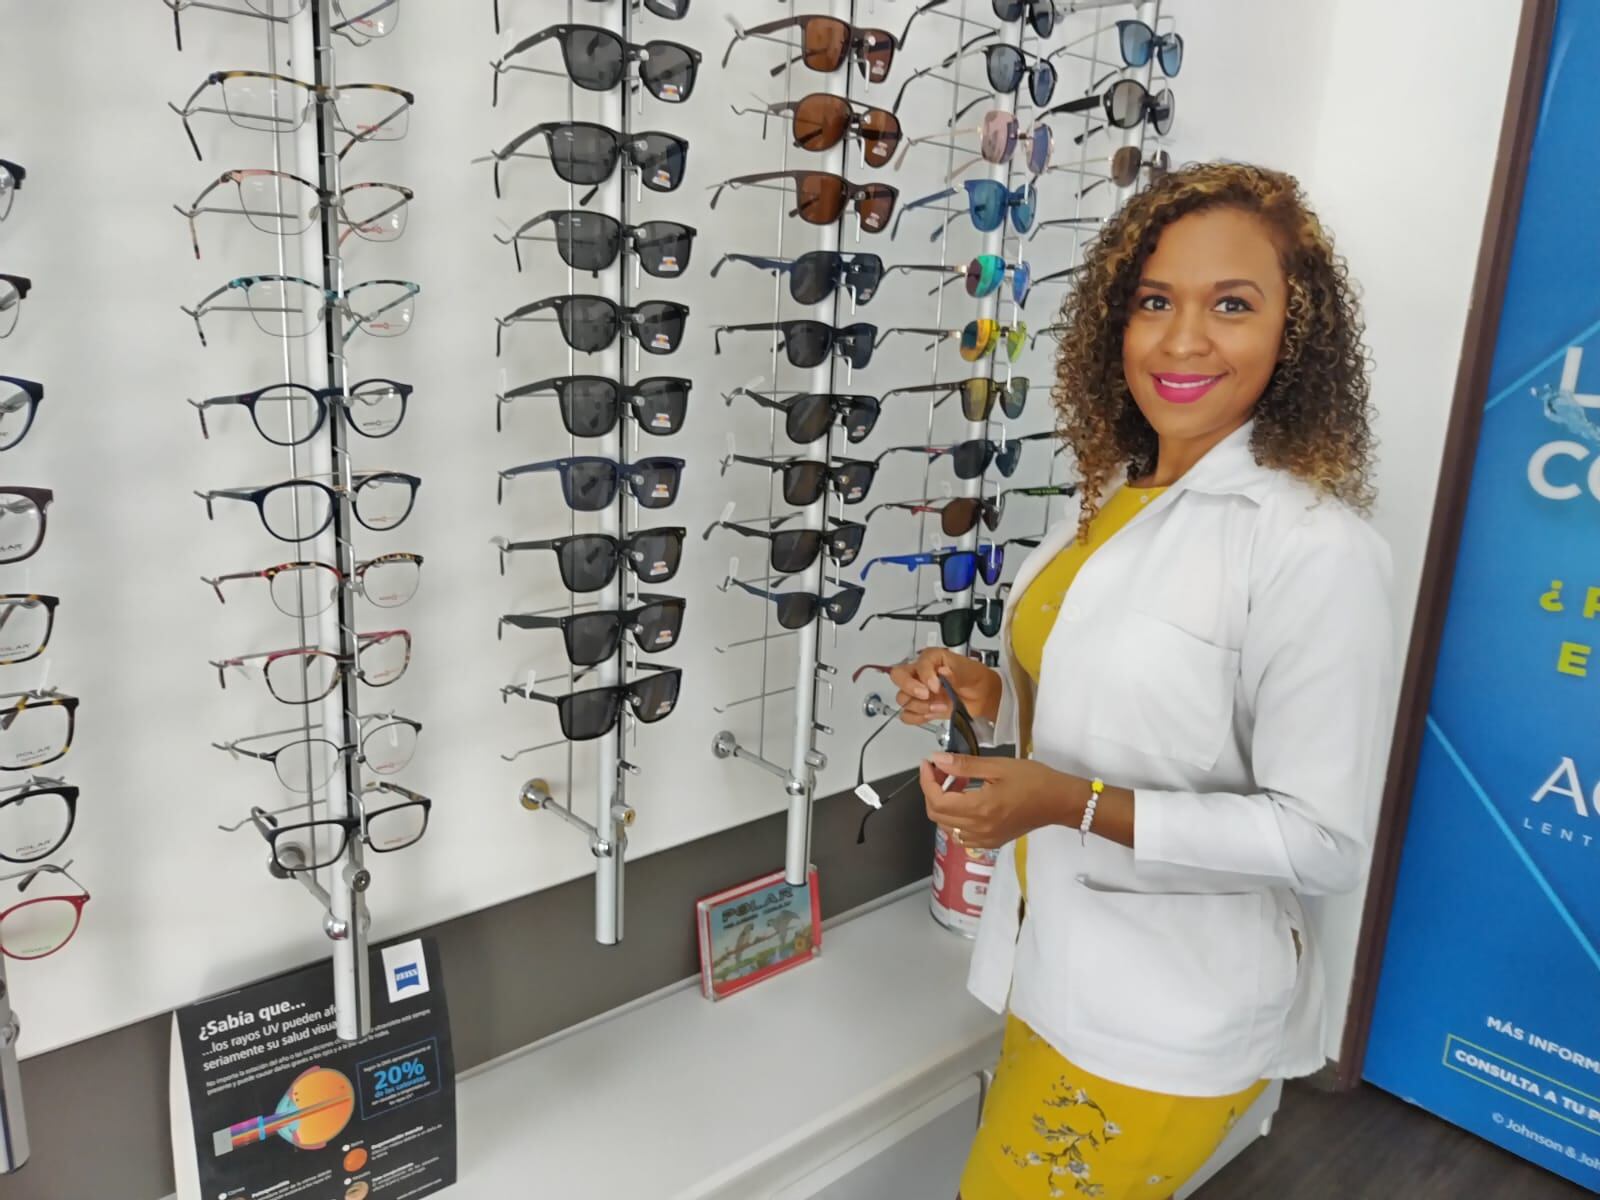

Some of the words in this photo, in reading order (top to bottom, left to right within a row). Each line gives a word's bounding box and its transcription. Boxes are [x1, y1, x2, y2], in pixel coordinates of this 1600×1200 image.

[1528, 440, 1600, 500] C
[1530, 755, 1600, 817] A
[199, 1011, 255, 1041] ¿Sabía
[258, 1001, 306, 1021] que...
[203, 1045, 265, 1071] seriamente
[266, 1040, 280, 1051] su
[282, 1027, 310, 1046] salud
[311, 1020, 337, 1035] visua
[231, 1030, 261, 1046] rayos
[262, 1022, 280, 1036] UV
[282, 1010, 322, 1033] pueden
[1486, 1016, 1524, 1041] MÁS
[1528, 1034, 1600, 1074] INFORM
[374, 1057, 424, 1090] 20%
[1455, 1050, 1540, 1096] CONSULTA
[1544, 1090, 1557, 1104] A
[1561, 1096, 1585, 1115] TU
[1506, 1119, 1562, 1153] Johnson
[1565, 1146, 1576, 1160] &
